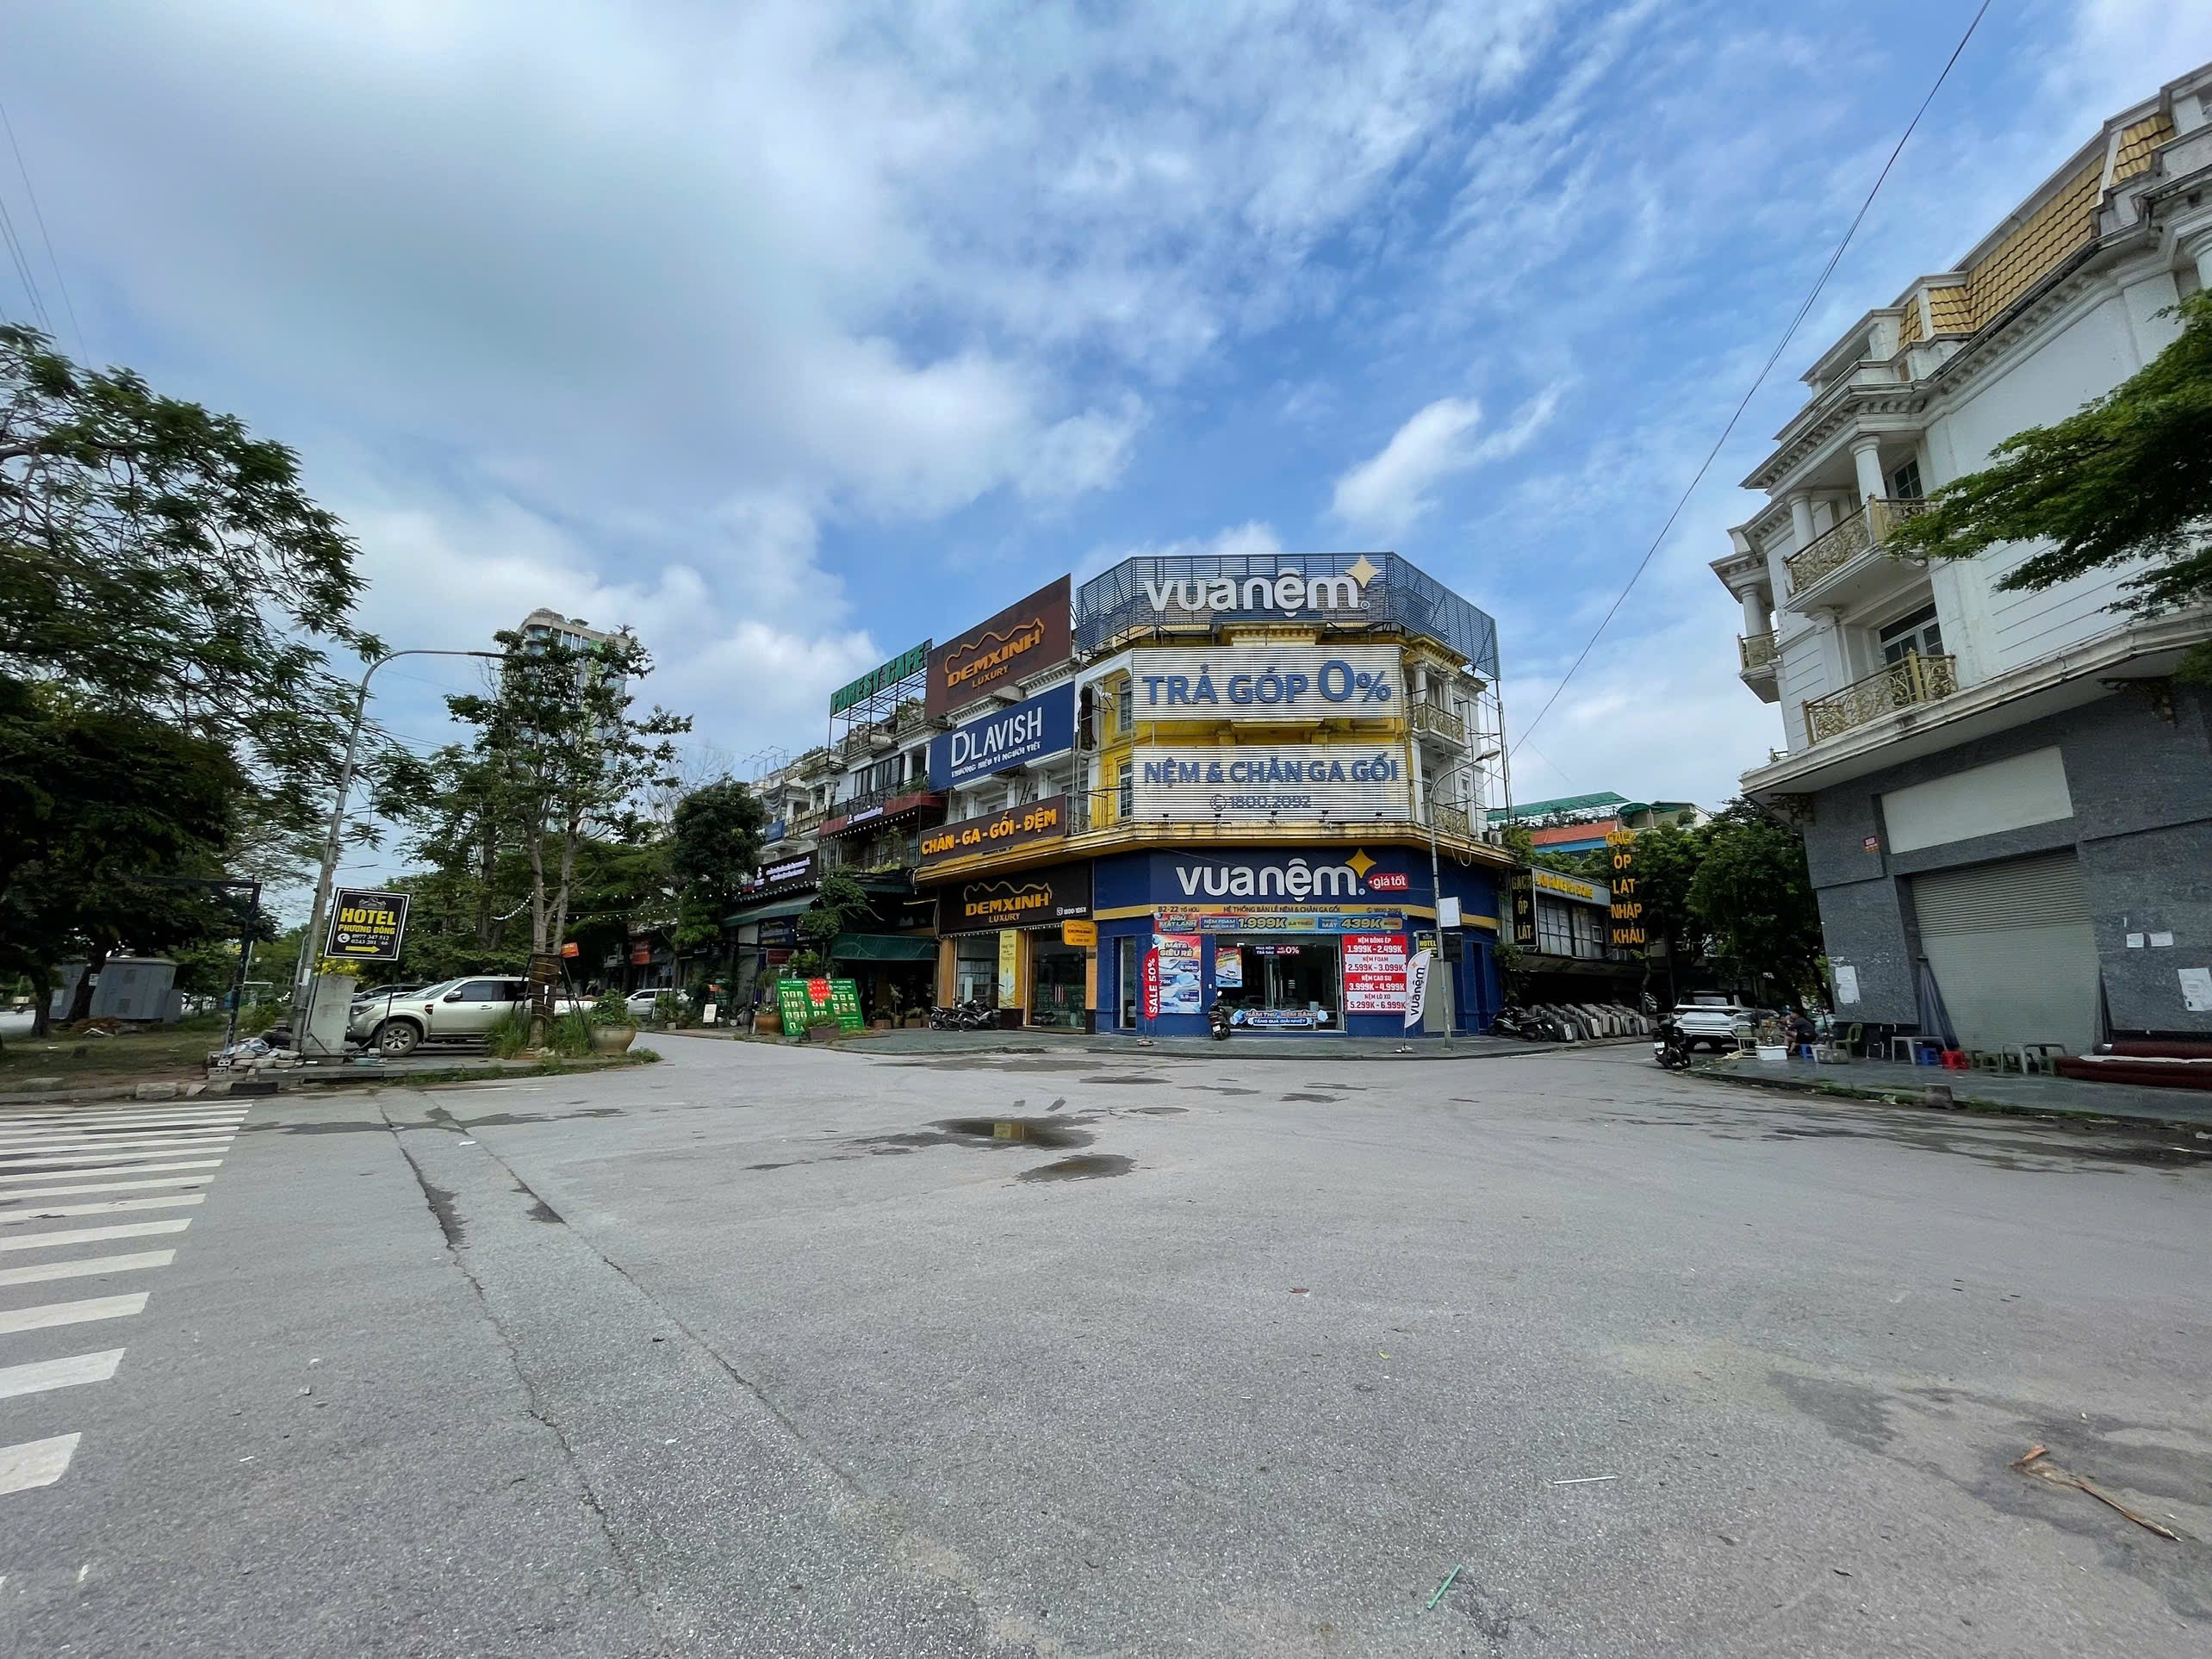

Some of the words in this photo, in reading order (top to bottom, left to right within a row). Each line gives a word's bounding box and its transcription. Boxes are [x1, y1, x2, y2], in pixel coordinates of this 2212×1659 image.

[1144, 567, 1358, 617] vuanệm
[948, 630, 1041, 687] DEMXINH
[832, 667, 881, 715] FOREST
[882, 643, 926, 685] CAFE
[972, 664, 1009, 688] LUXURY
[1142, 663, 1218, 704] TRẢ
[1228, 667, 1308, 704] GÓP
[1318, 660, 1391, 703] 0%
[1002, 745, 1025, 761] NGƯỜI
[1026, 741, 1041, 754] VIỆT
[1144, 756, 1200, 788] NỆM
[1206, 761, 1225, 783] &
[1230, 756, 1302, 783] CHĂN
[1309, 761, 1345, 782] GA
[1351, 751, 1399, 782] GỐI
[1176, 858, 1357, 902] vuanệm
[1374, 876, 1390, 889] giá
[1391, 875, 1406, 886] tốt
[966, 892, 1049, 916] DEMXINH
[1518, 896, 1528, 915] ỐP
[339, 908, 396, 926] HOTEL
[988, 913, 1020, 923] LUXURY
[1238, 917, 1286, 929] 1.999K
[1341, 917, 1382, 929] 439K
[338, 924, 371, 933] PHƯƠNG
[1518, 923, 1531, 940] LÁT
[1159, 948, 1179, 957] SIÊU
[1380, 983, 1405, 991] 4.999K
[1411, 967, 1425, 1016] vuanệm
[1149, 985, 1158, 1014] SALE
